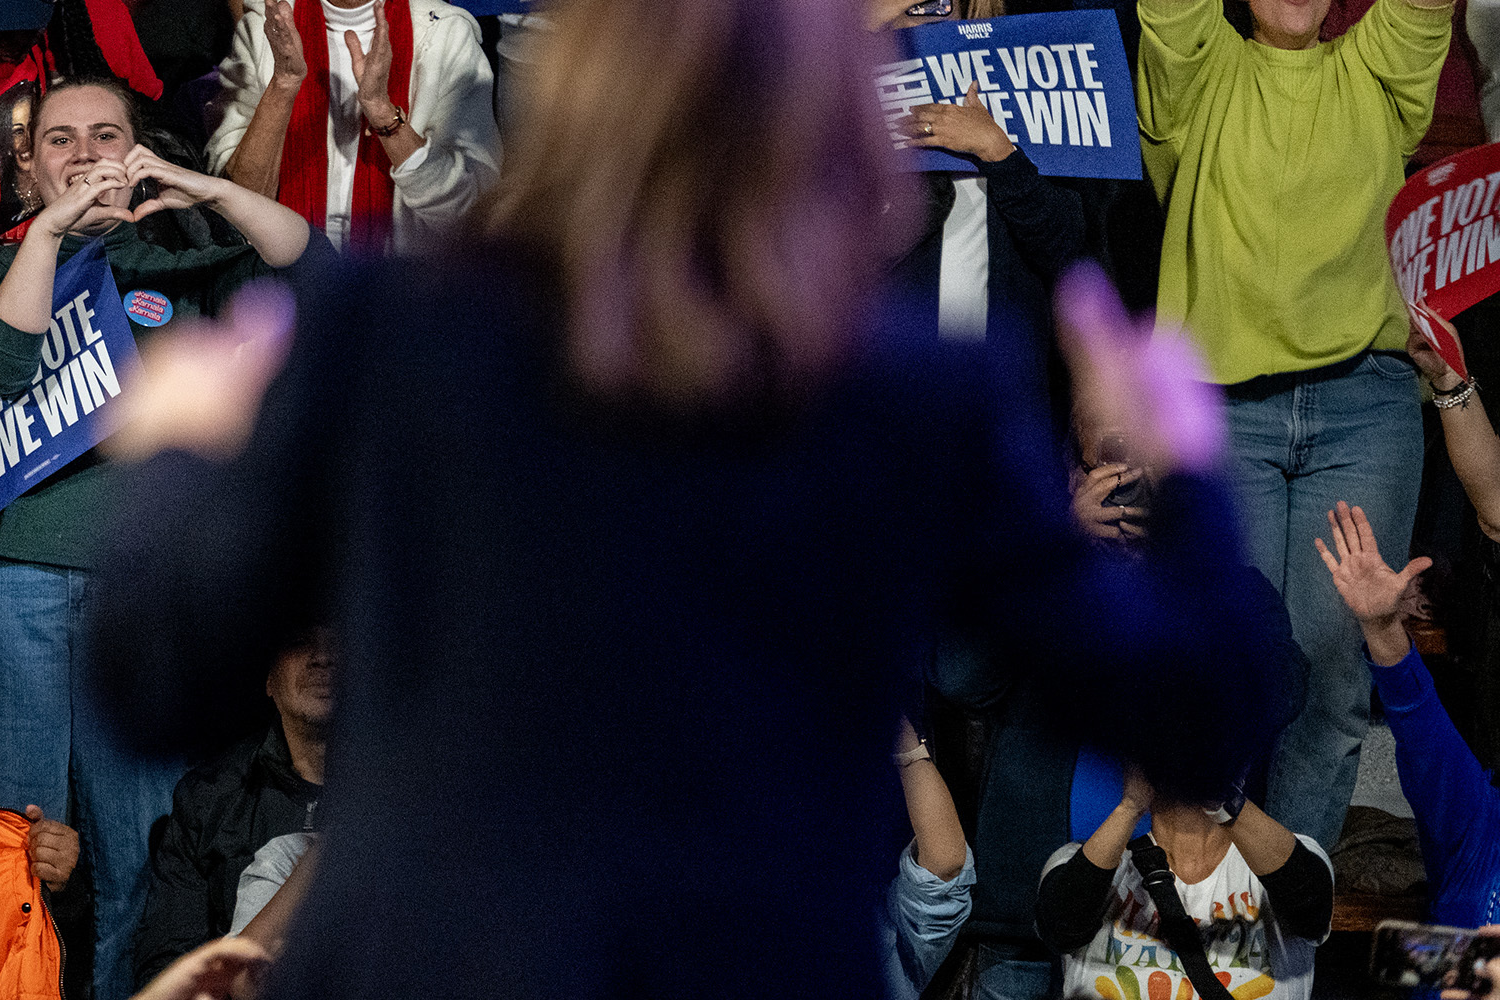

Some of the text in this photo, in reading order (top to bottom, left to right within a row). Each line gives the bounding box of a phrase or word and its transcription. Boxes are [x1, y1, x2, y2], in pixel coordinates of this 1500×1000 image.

[958, 22, 993, 35] HARRIS
[965, 32, 990, 40] WALZ
[926, 43, 1104, 98] WE VOTE
[1014, 90, 1112, 148] WIN
[1440, 170, 1500, 236] VOT
[128, 305, 162, 322] Kamala
[131, 297, 165, 315] Kamala
[134, 291, 167, 307] Kamala
[31, 289, 103, 386] OTE
[32, 339, 122, 438] WIN
